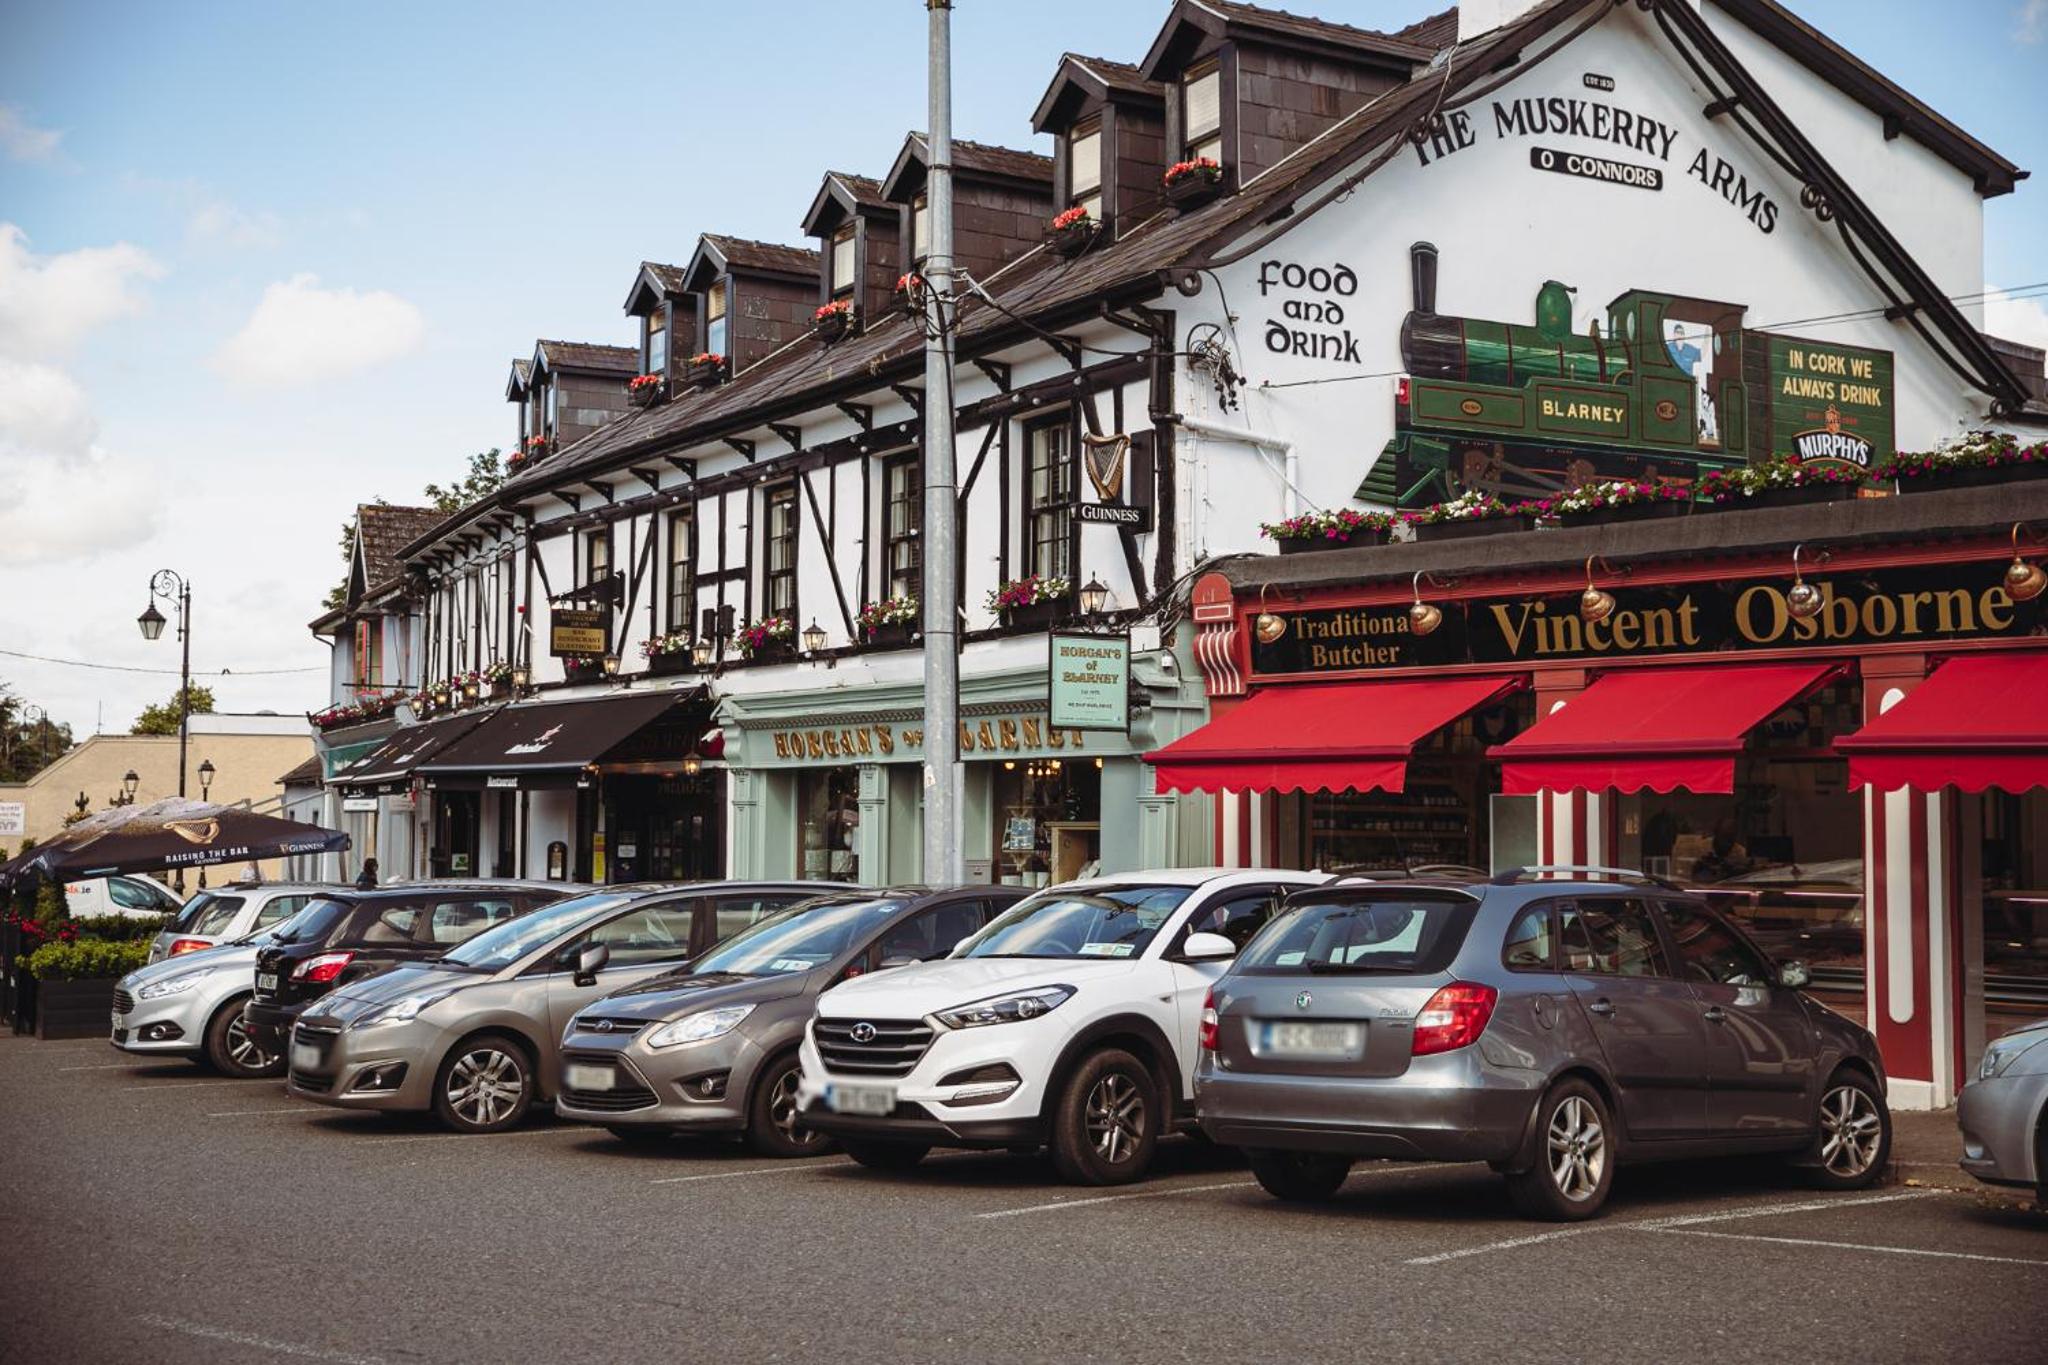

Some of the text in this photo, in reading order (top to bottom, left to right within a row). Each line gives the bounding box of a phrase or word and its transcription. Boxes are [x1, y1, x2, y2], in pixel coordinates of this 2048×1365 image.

[1493, 97, 1678, 162] MUSKERRY
[1687, 147, 1778, 235] ARMS
[1541, 151, 1657, 188] O CONNORS
[1790, 349, 1873, 379] IN CORK WE
[1782, 376, 1882, 407] ALWAYS DRINK
[1543, 400, 1624, 423] BLARNEY
[1798, 434, 1868, 465] MURPHY'S
[1291, 613, 1410, 639] Traditiona
[1489, 581, 2015, 656] Vincent Osborne
[1060, 646, 1122, 660] HORGAN'S
[1312, 642, 1400, 667] Butcher
[1063, 671, 1119, 685] BLARNEY
[774, 724, 894, 759] HORGAN'S
[960, 717, 1083, 752] LARNE
[165, 846, 249, 864] RAISING THE BAR
